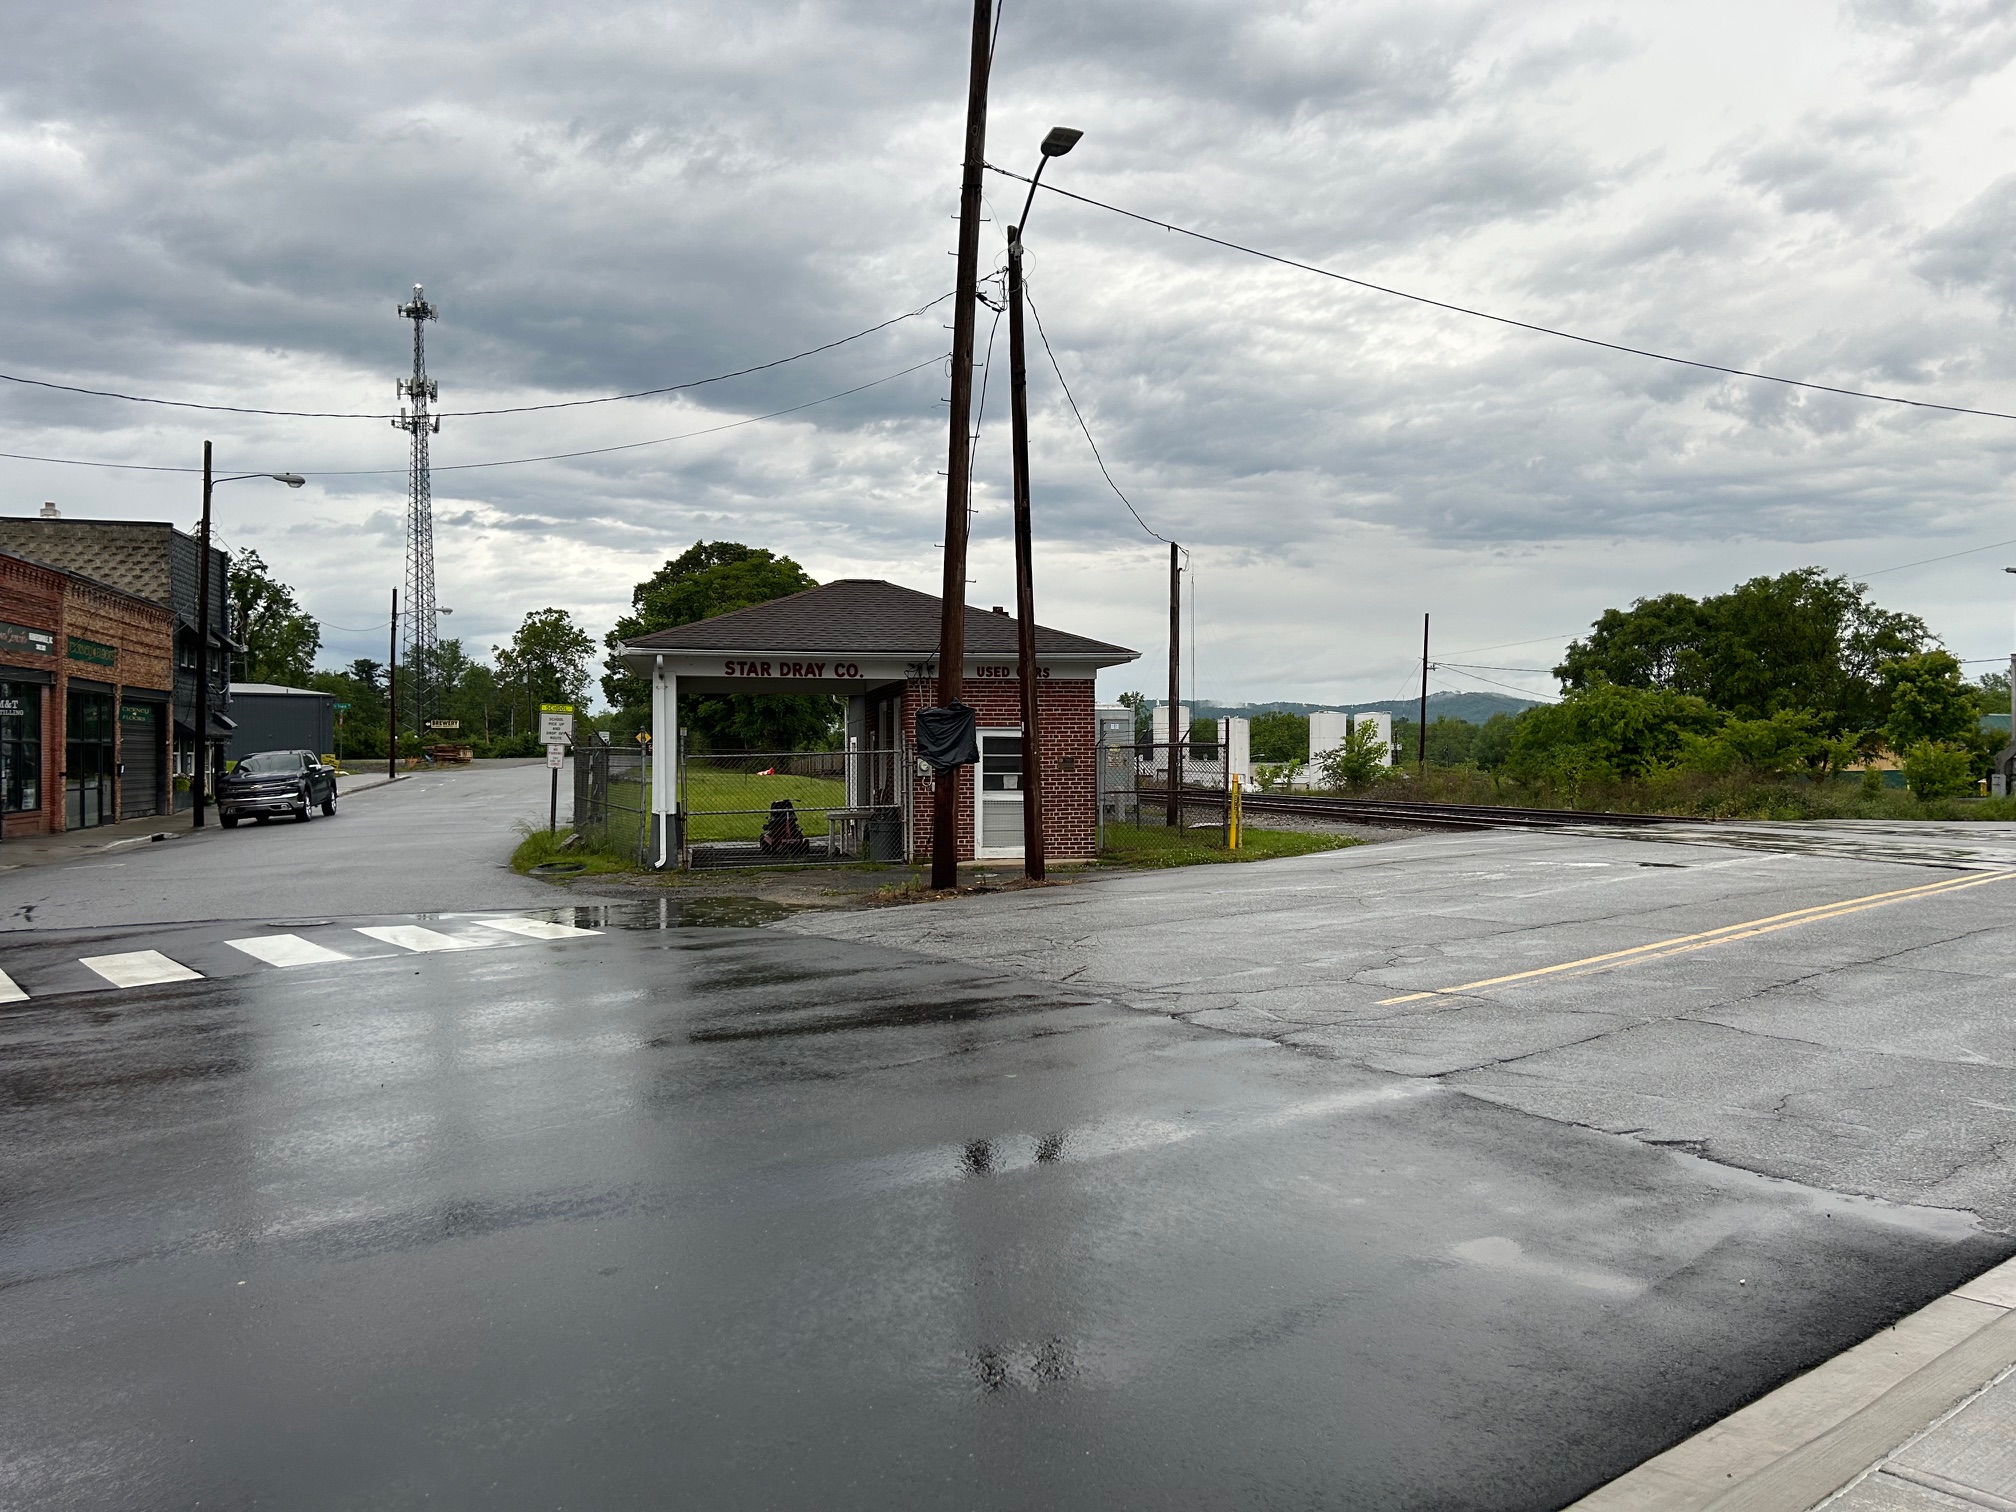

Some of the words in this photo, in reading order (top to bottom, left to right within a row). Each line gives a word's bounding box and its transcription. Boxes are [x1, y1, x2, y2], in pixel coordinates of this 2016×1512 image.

[725, 660, 772, 677] STAR
[779, 662, 826, 677] DRAY
[834, 662, 864, 678] CO.
[976, 666, 1010, 678] USED
